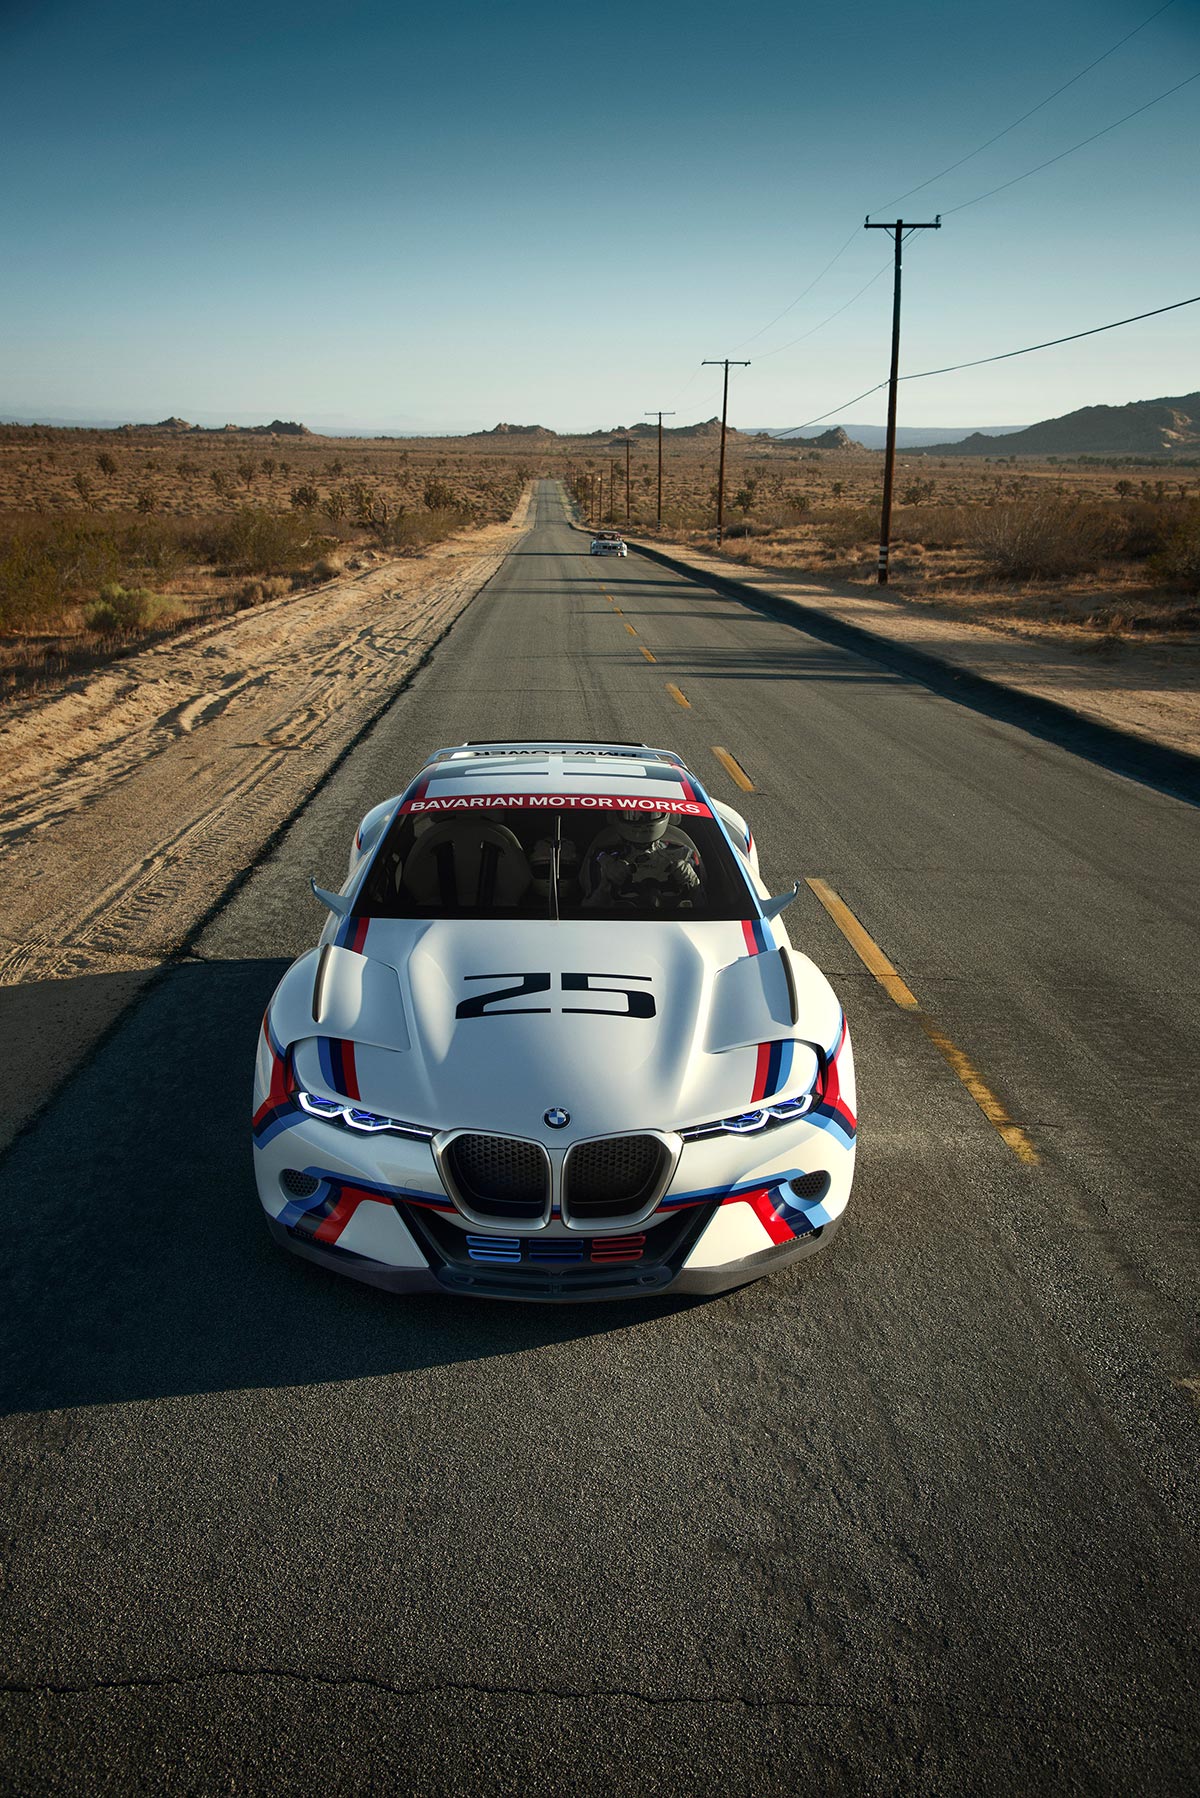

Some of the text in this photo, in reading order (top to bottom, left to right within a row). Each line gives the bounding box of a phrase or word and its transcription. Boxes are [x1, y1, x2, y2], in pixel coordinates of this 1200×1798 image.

[410, 796, 701, 814] BAVARIAN MOTOR WORKS
[455, 972, 657, 1020] 25
